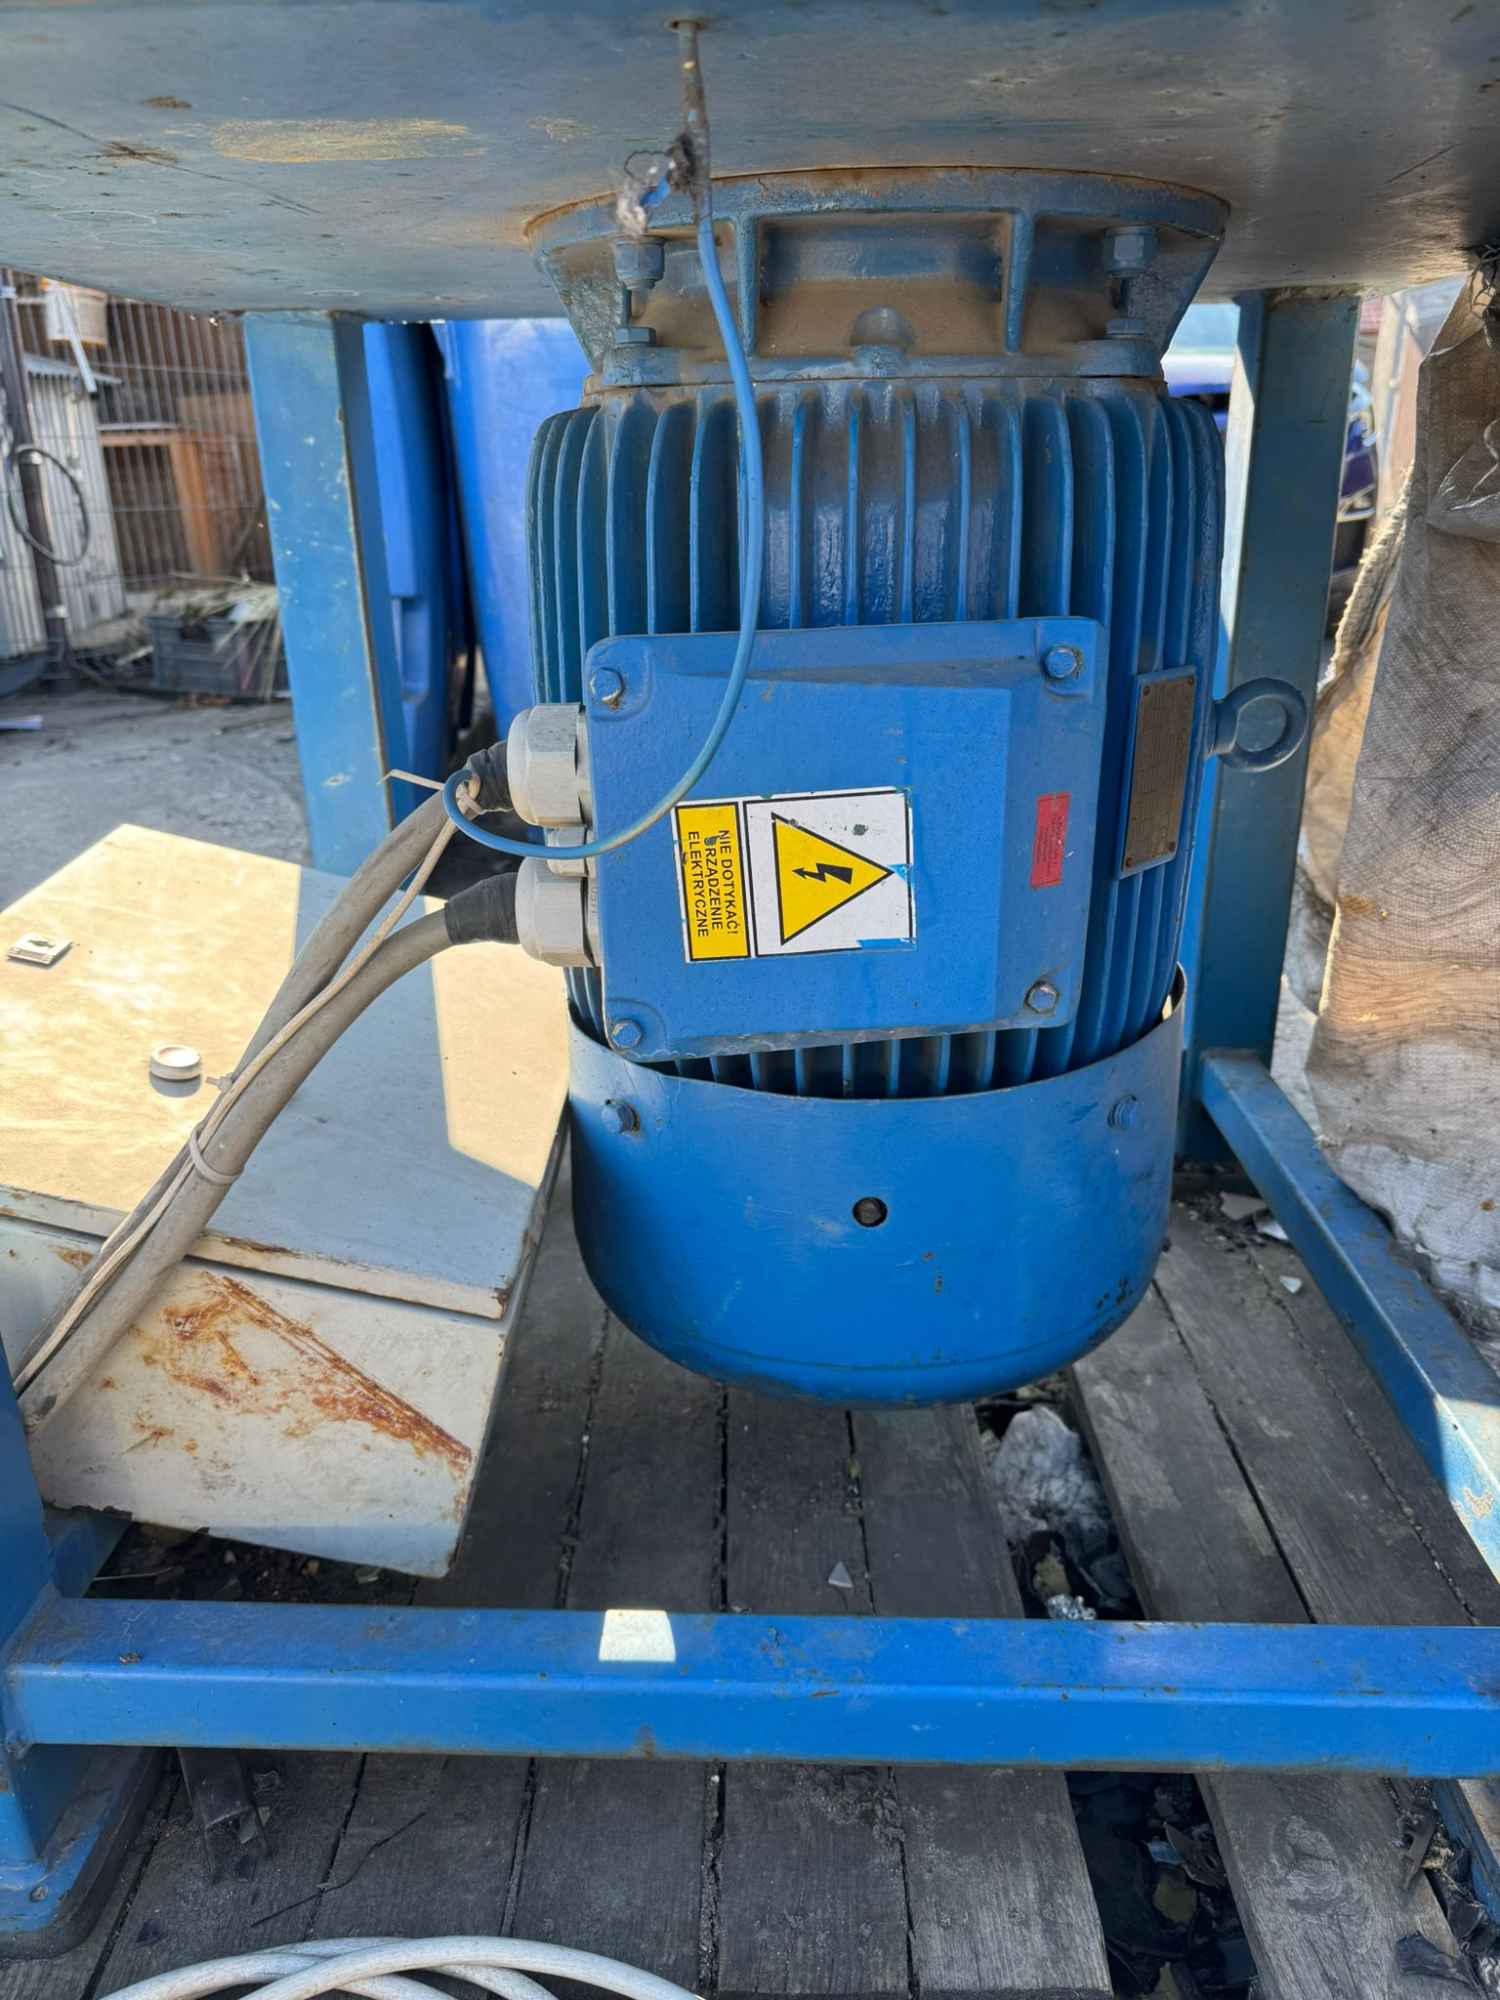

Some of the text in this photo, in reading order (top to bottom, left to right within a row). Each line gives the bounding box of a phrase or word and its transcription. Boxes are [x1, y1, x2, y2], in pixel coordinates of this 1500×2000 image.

[688, 831, 709, 937] ELEKTRYCZNE
[704, 837, 723, 930] RZĄDZENIE
[717, 830, 740, 934] NIE DOTYKAĆ!
